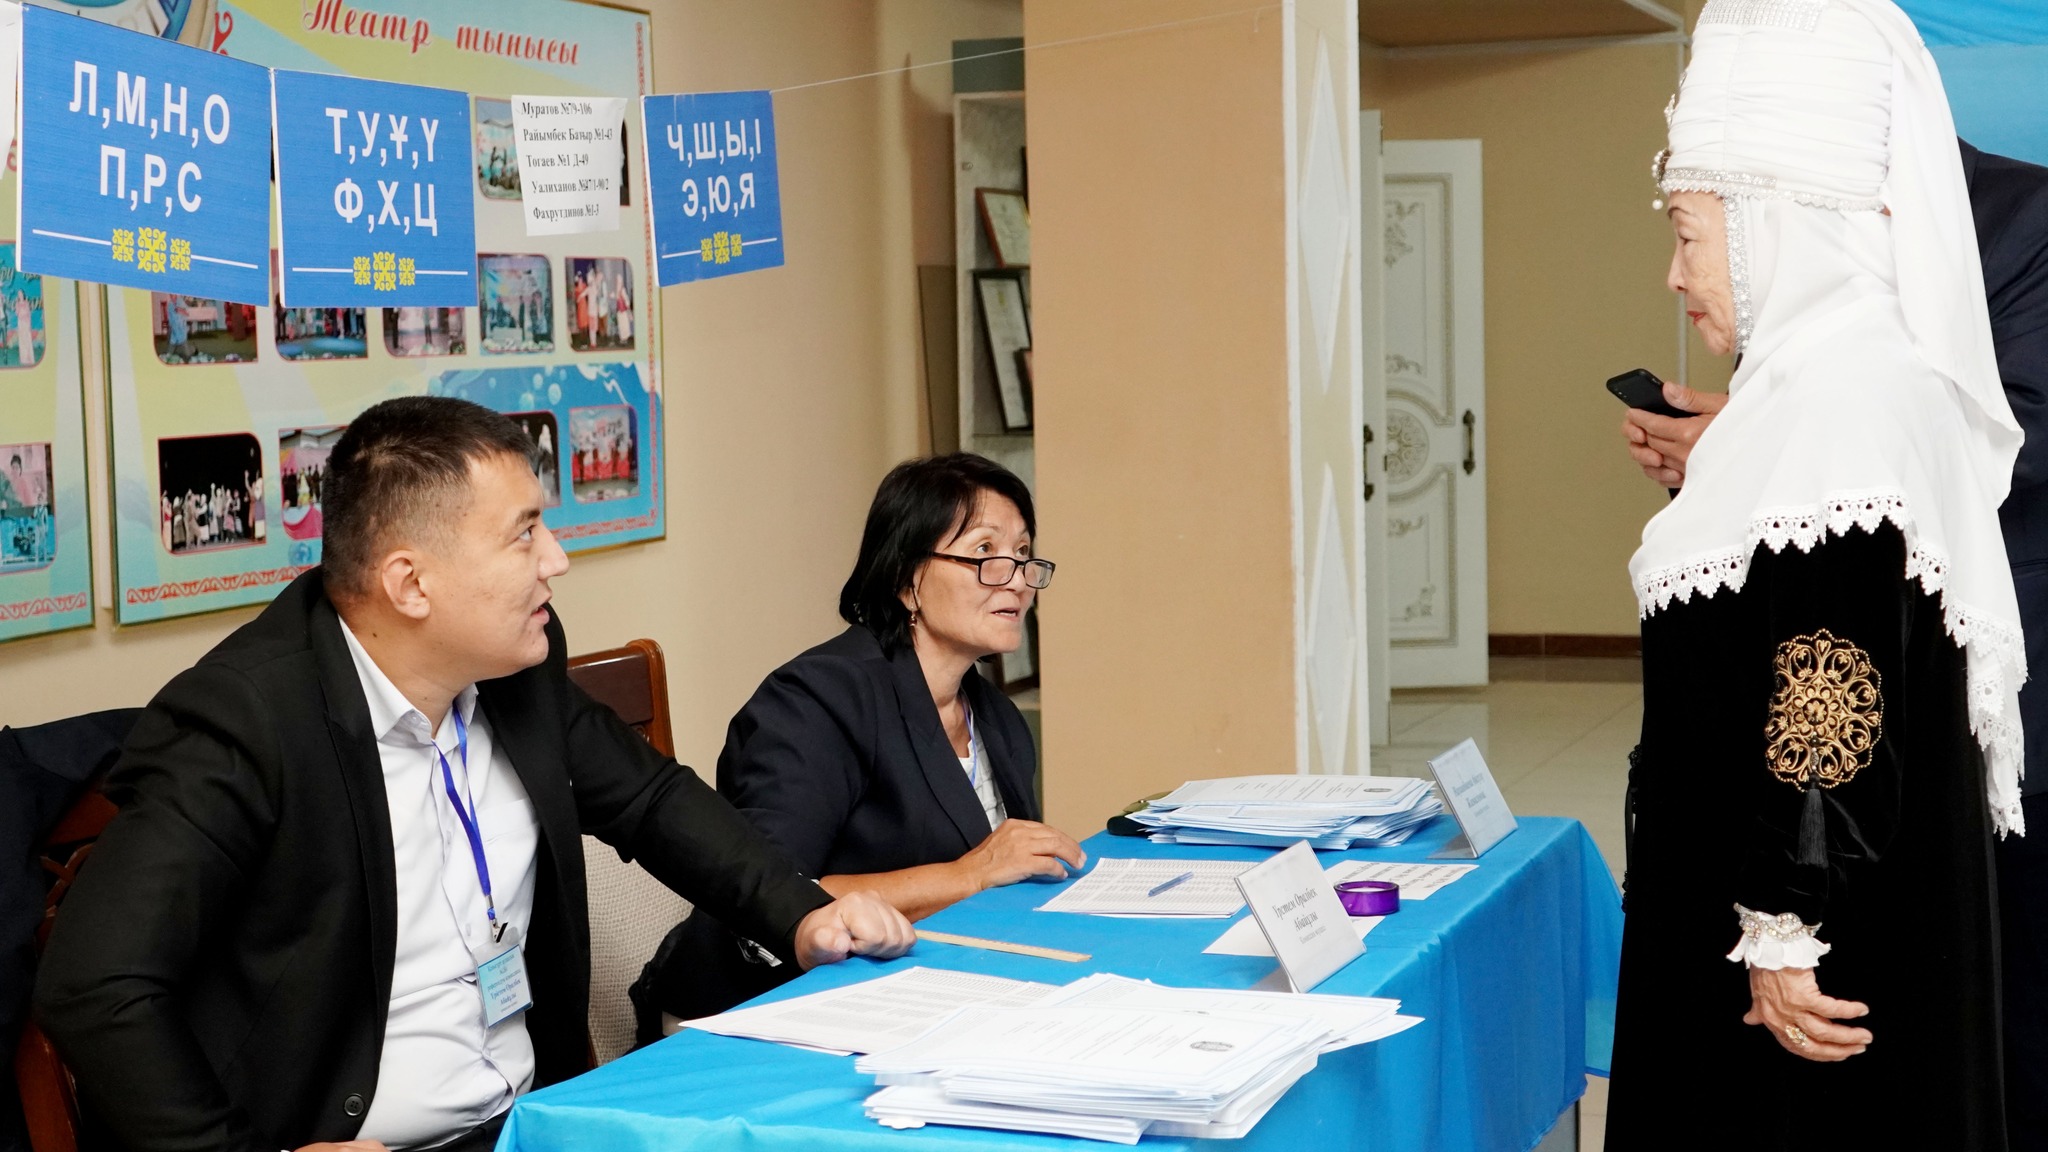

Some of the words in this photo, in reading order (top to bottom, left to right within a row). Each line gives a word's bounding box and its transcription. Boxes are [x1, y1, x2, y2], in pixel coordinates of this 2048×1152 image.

[303, 0, 431, 54] Театр
[456, 25, 579, 65] тынысы
[69, 60, 230, 148] Л,М,Н,О
[521, 102, 559, 118] Муратов
[325, 107, 439, 170] Т,У,Ұ,Ү
[523, 128, 567, 141] Райымбек
[569, 128, 593, 144] Батыр
[526, 154, 556, 167] Тогаев
[667, 118, 761, 168] Ч,Ш,Ы,І
[100, 144, 202, 217] П,Р,С
[532, 180, 577, 194] Уалиханов
[682, 172, 755, 222] Э,Ю,Я
[334, 178, 438, 236] Ф,Х,Ц
